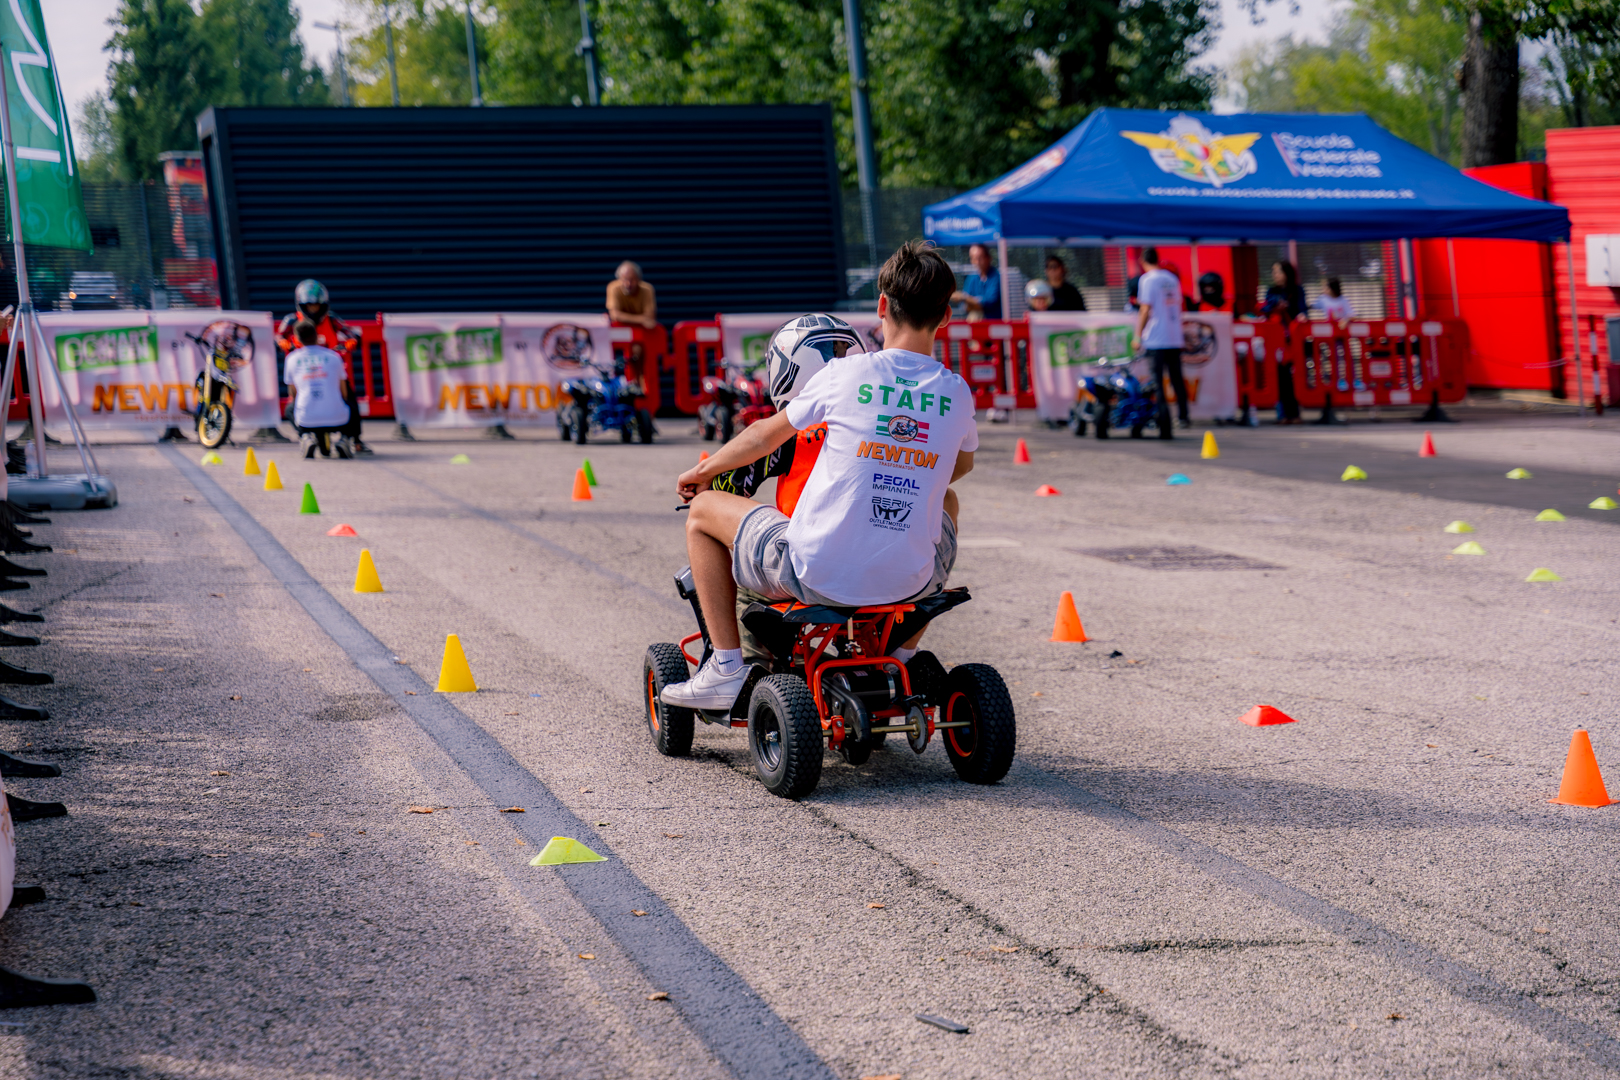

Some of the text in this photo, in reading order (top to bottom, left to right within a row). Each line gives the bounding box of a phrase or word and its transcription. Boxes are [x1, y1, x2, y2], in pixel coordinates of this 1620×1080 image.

[857, 384, 951, 416] STAFF
[856, 441, 940, 469] NEWTON
[878, 461, 915, 471] TRASFORMATORI
[873, 473, 920, 490] PEGAL
[872, 483, 910, 495] IMPIANTI
[871, 496, 914, 510] BERIK
[869, 517, 911, 529] OUTLETMOTO.EU
